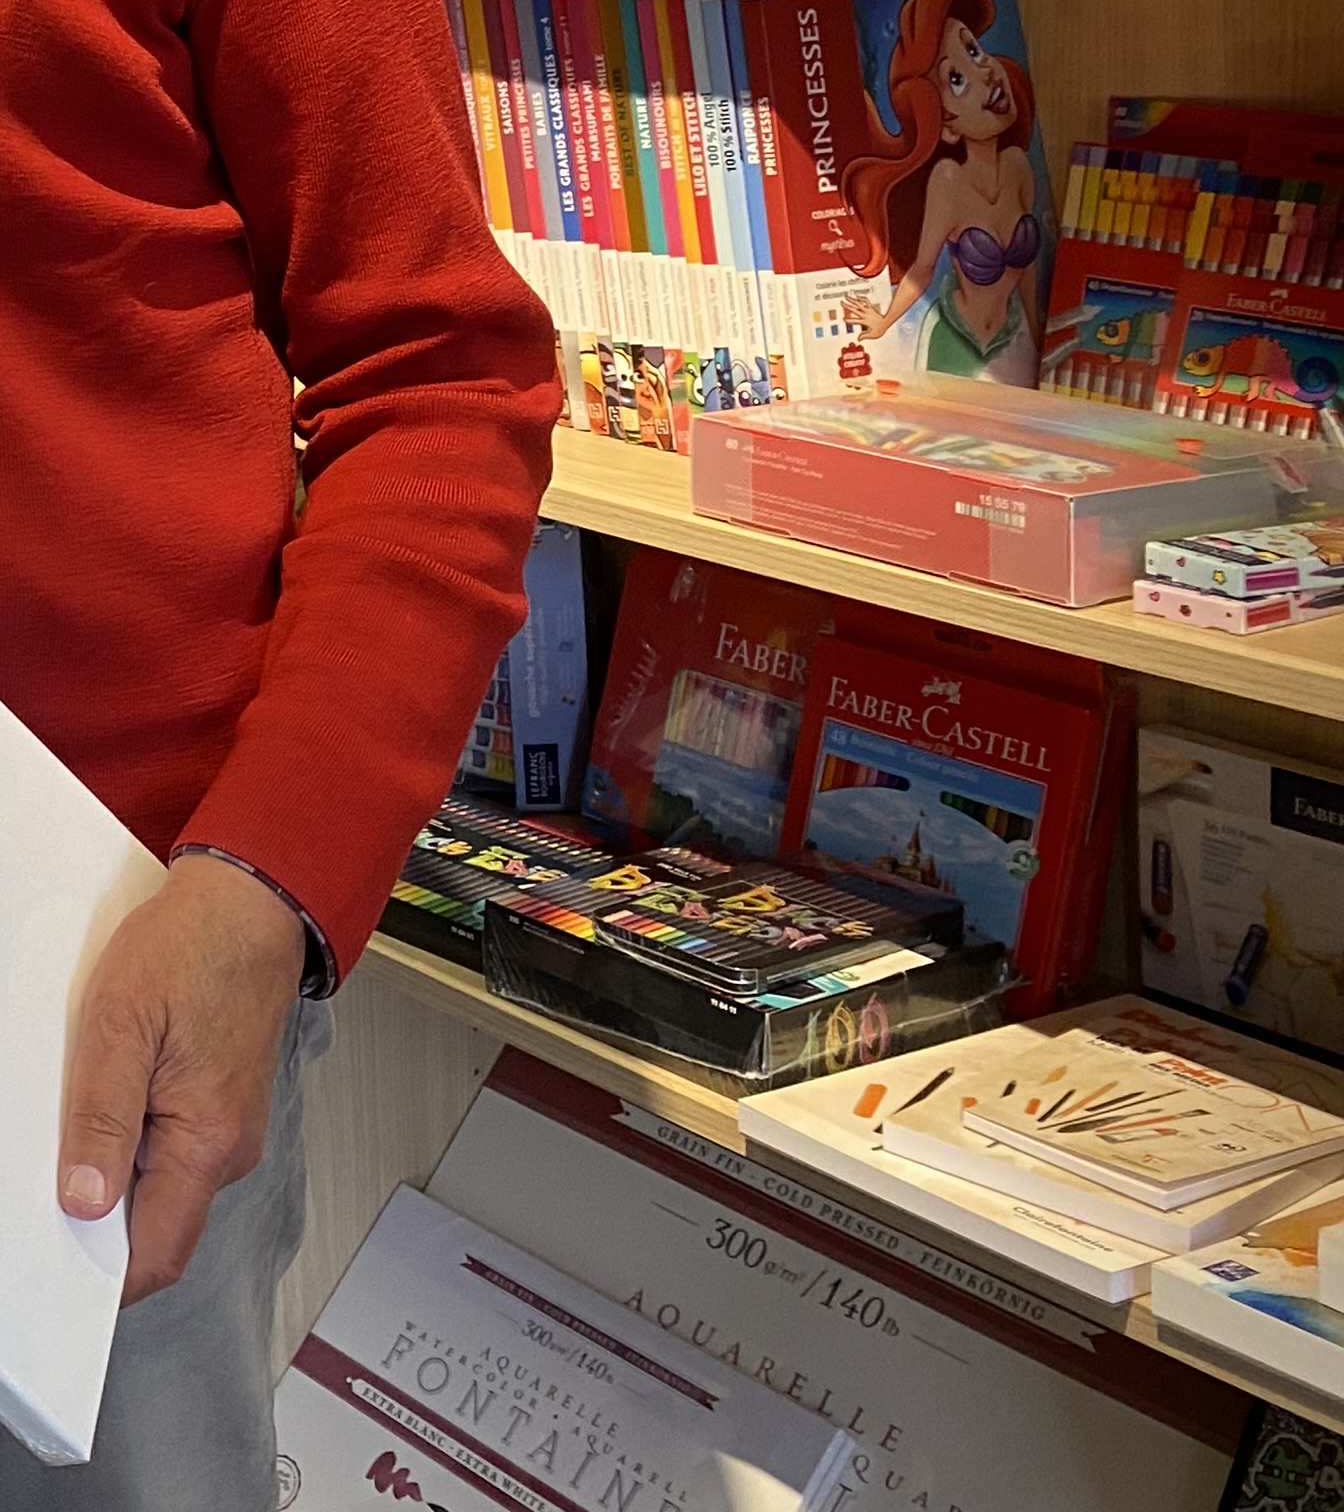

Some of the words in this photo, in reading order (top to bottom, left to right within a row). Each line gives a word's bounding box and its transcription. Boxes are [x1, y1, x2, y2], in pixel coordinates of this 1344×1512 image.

[497, 80, 514, 136] SAISONS
[531, 91, 547, 138] BABIES
[544, 53, 565, 131] CLASSIQUES
[681, 90, 702, 144] STITCH
[797, 6, 840, 196] PRINCESSES
[554, 130, 572, 188] GRANDS
[689, 144, 703, 165] ET
[691, 164, 708, 198] LILO
[562, 190, 576, 213] LES
[714, 621, 811, 686] FABER
[825, 675, 1052, 773] FABER-CASTELL
[656, 1125, 711, 1158] GRAIN
[713, 1153, 747, 1175] FIN
[763, 1176, 814, 1209] COLD
[819, 1203, 901, 1251] PRESSED
[918, 1250, 1047, 1322] FEINKÖRNIG
[1011, 1204, 1115, 1254] Clairefontaine
[480, 1346, 619, 1439] AQUARELLE
[623, 1288, 904, 1453] AQUARELLE
[362, 1386, 404, 1416] EXTRA
[404, 1411, 448, 1452] BLANC
[454, 1446, 499, 1484] EXTRA
